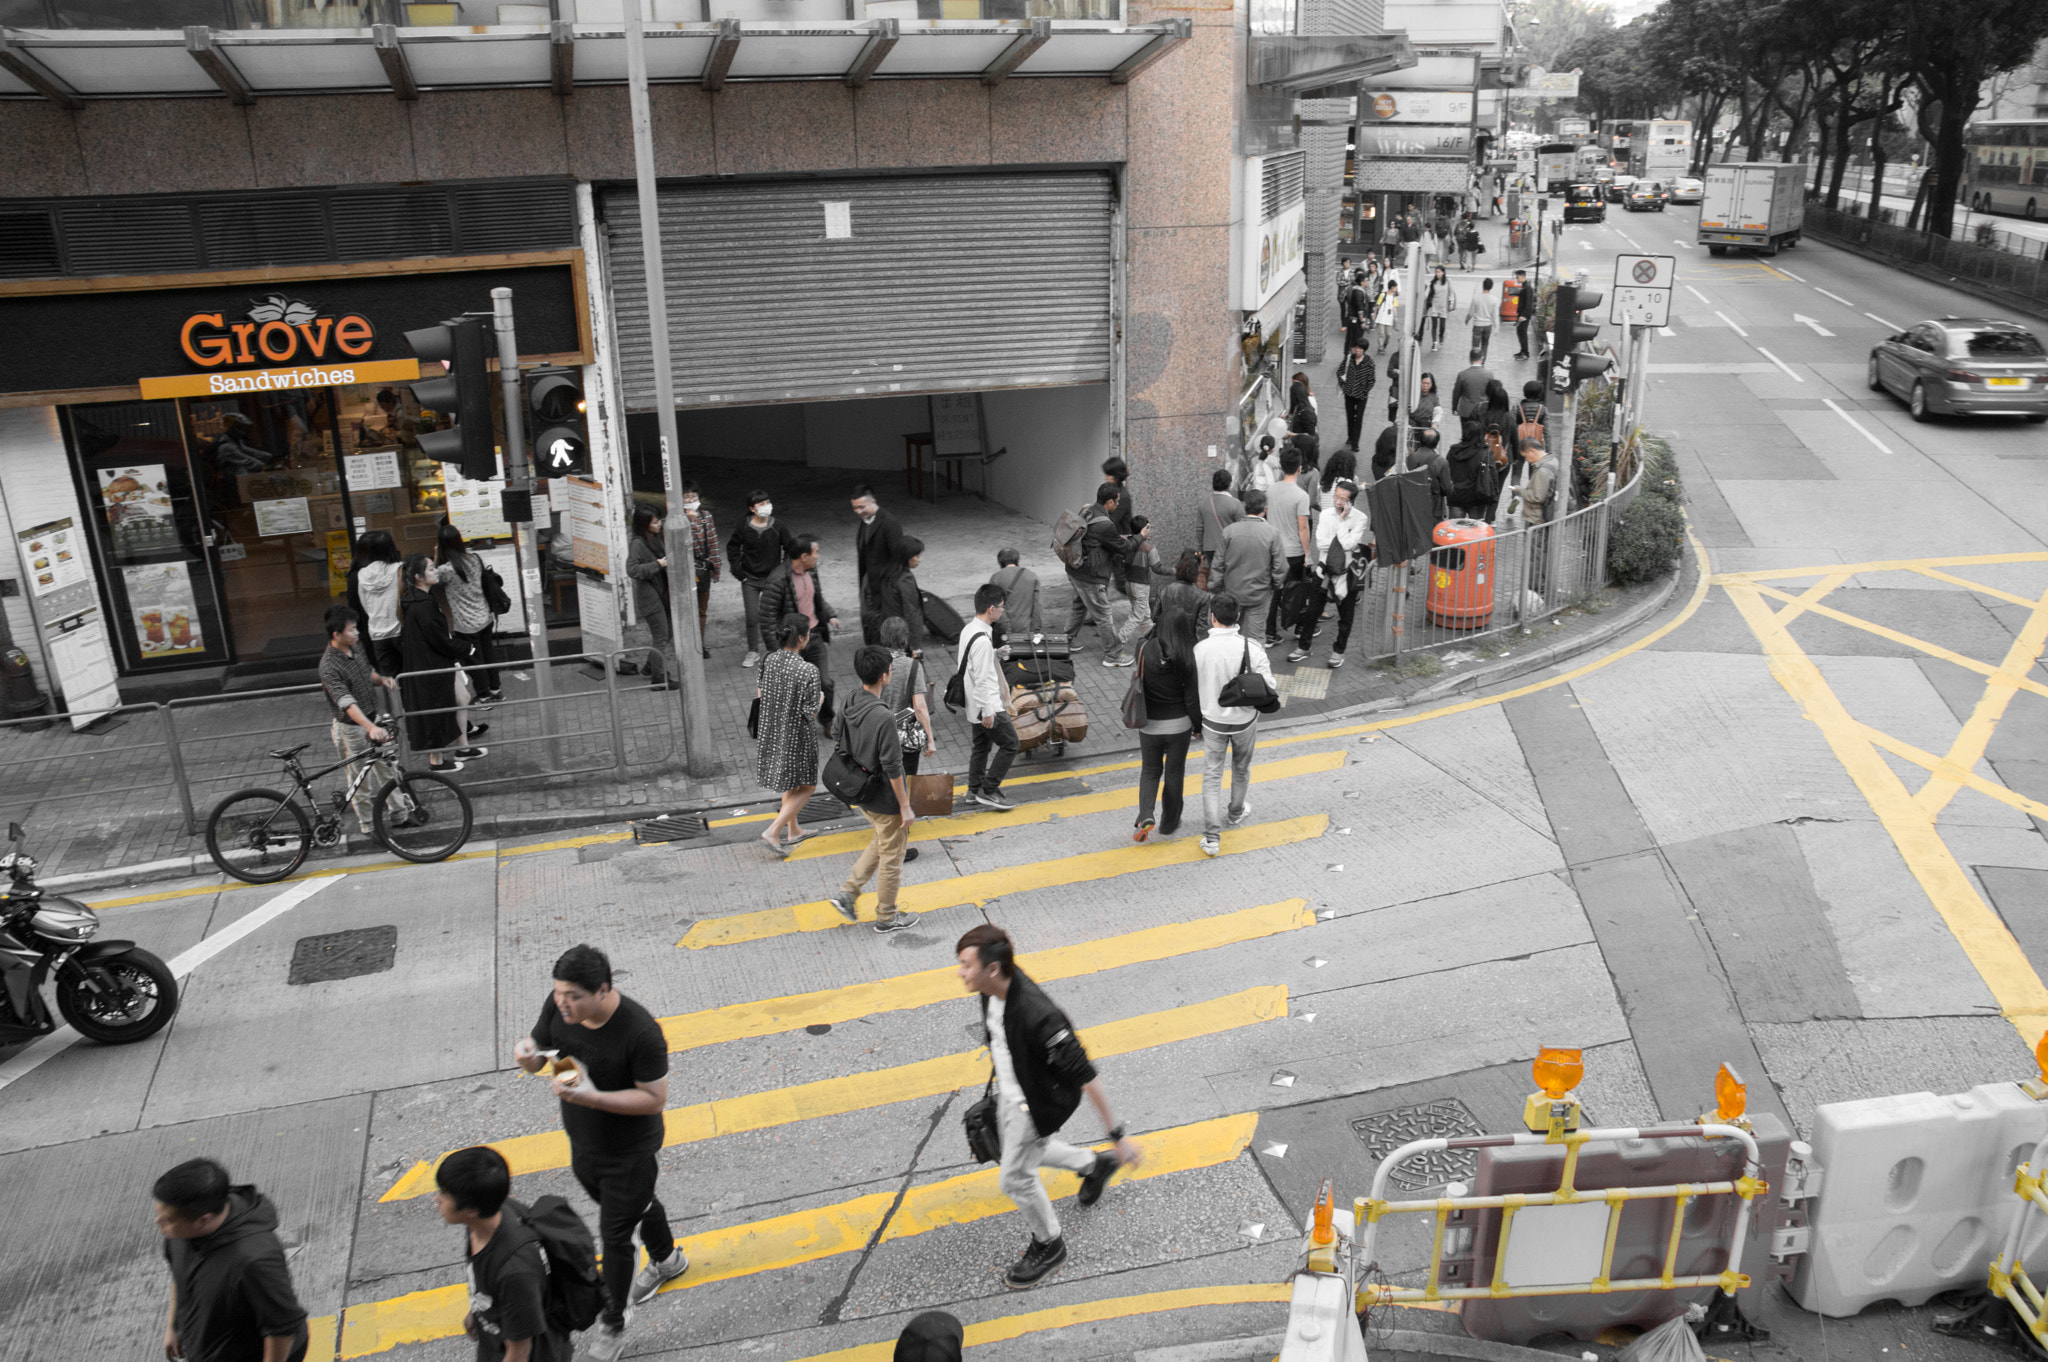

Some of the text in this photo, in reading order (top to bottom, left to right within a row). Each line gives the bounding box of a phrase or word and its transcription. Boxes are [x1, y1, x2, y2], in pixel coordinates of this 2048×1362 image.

[1448, 102, 1468, 113] 9/F
[1436, 136, 1463, 149] 16/F
[1647, 292, 1662, 304] 10
[1645, 312, 1653, 323] 9
[181, 313, 373, 367] Grove
[209, 368, 355, 394] Sandwiches
